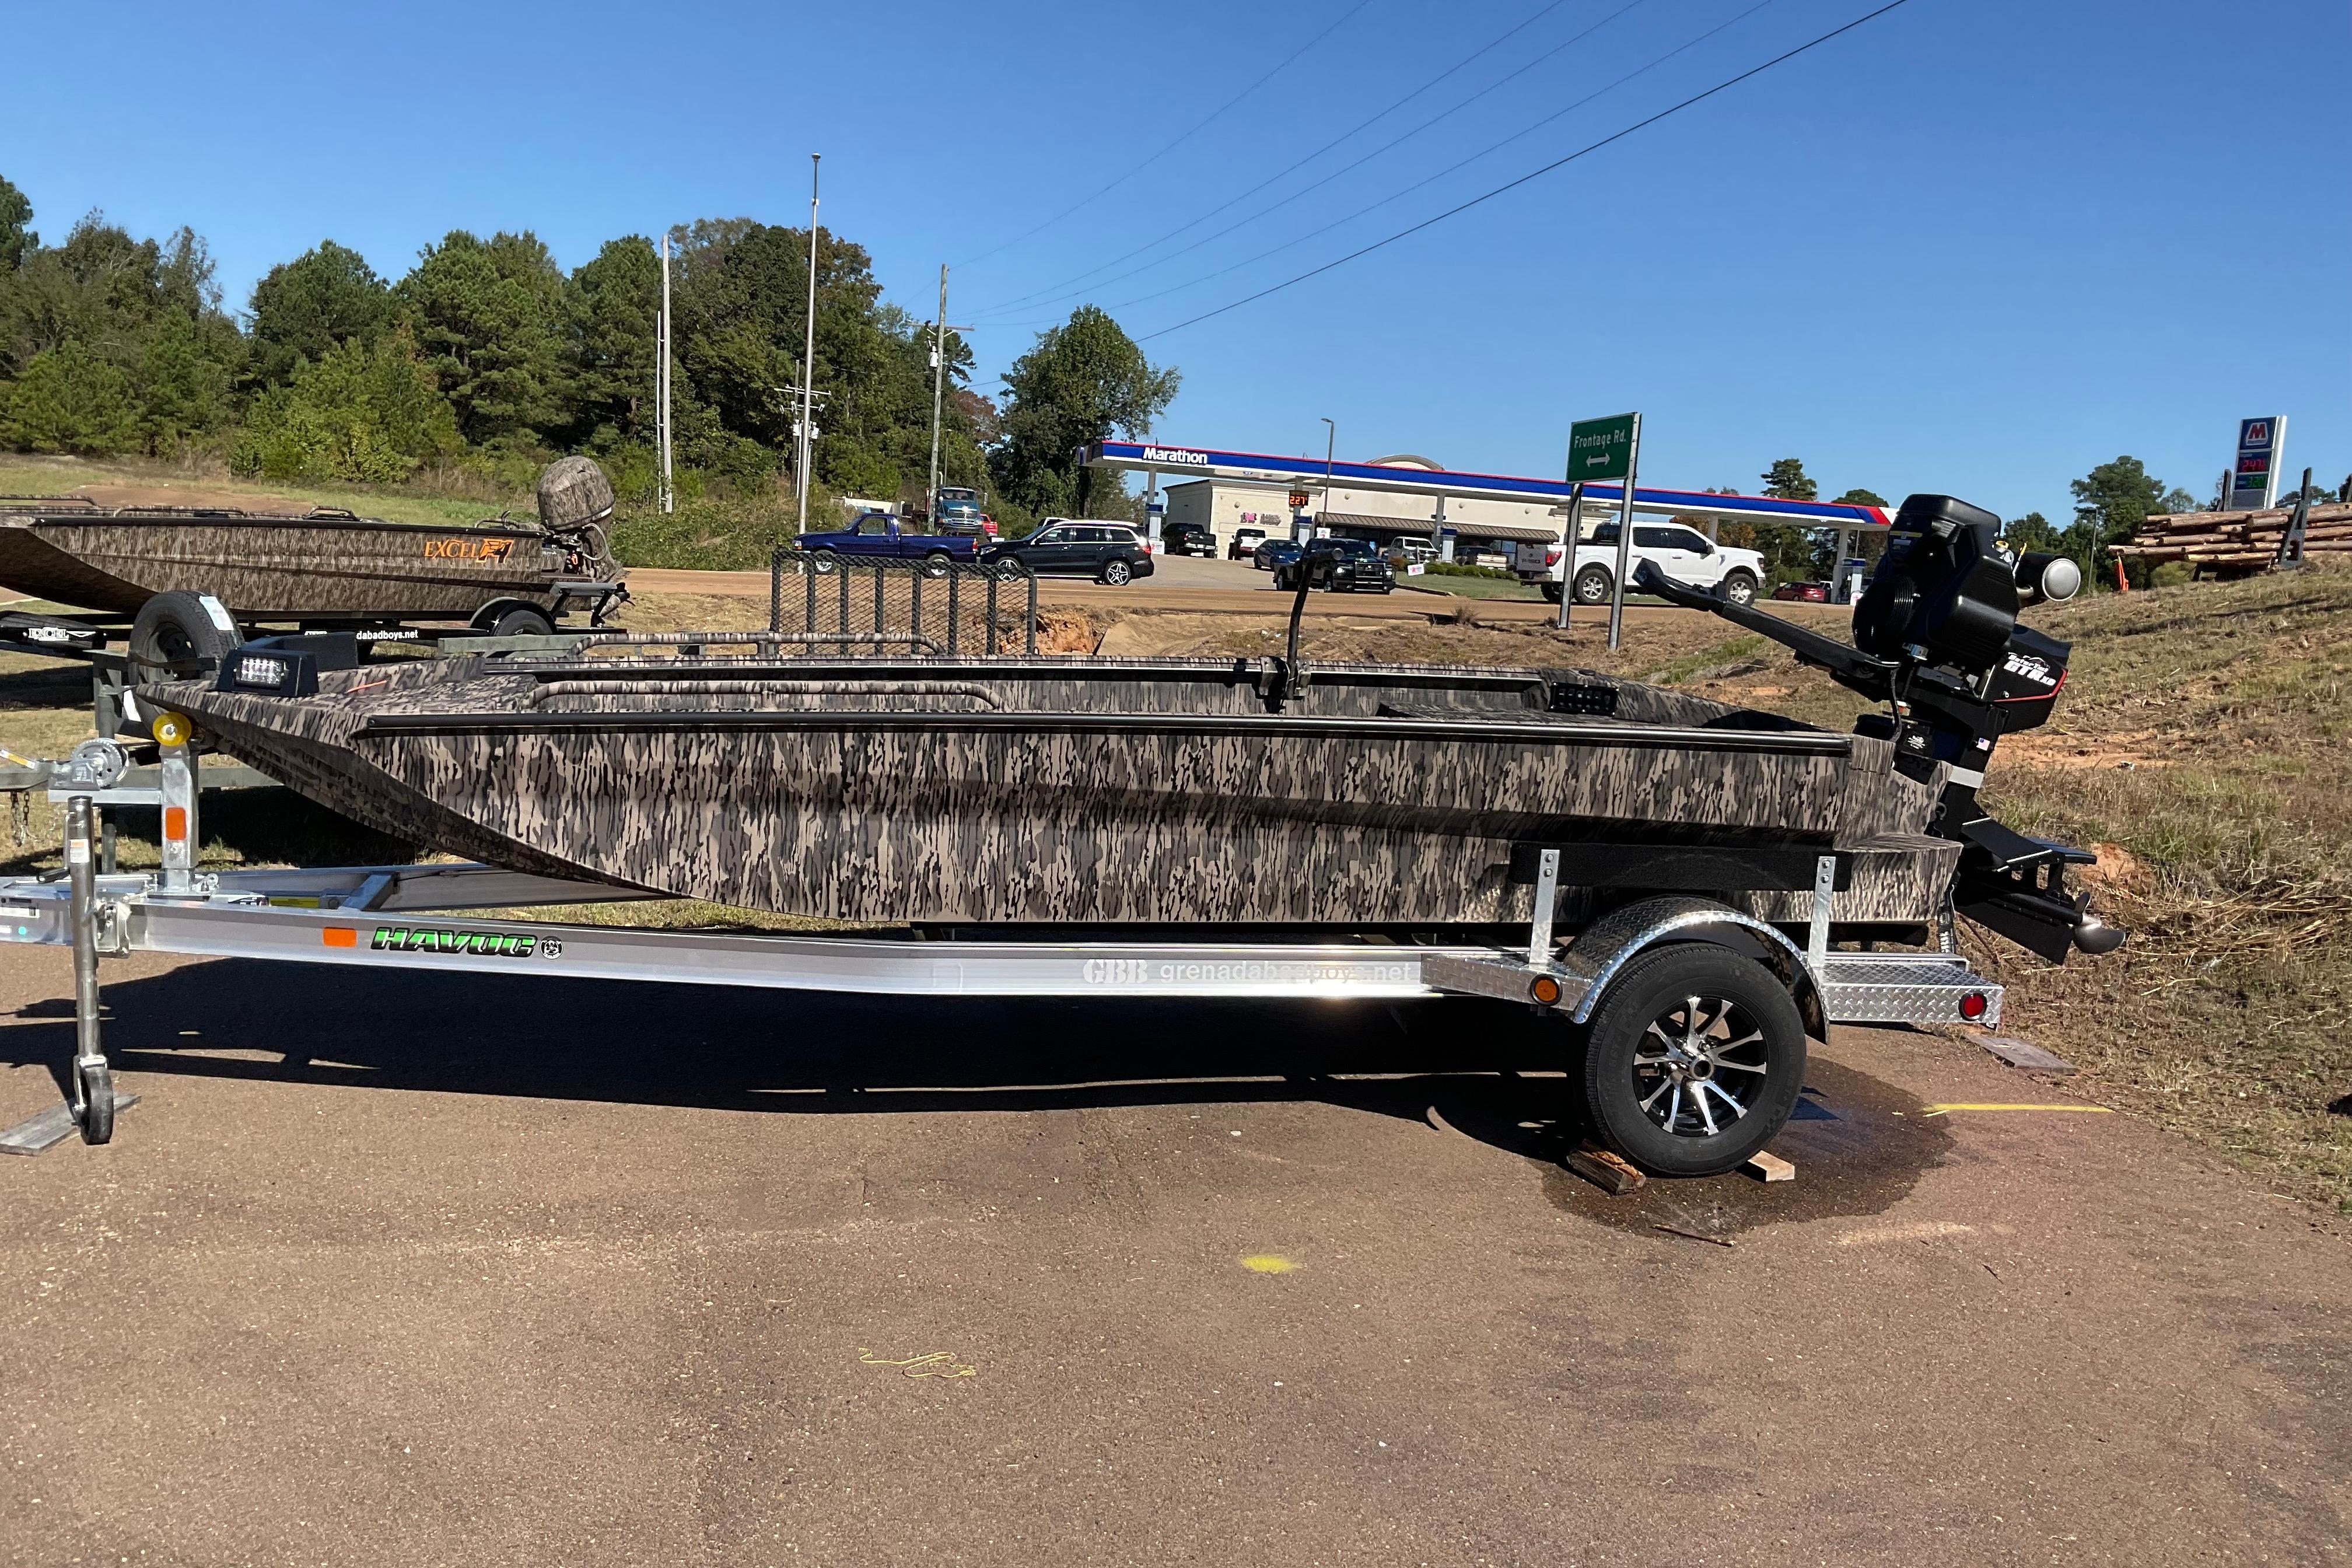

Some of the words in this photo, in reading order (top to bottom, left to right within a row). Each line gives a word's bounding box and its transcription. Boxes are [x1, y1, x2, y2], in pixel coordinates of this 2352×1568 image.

[1574, 433, 1611, 449] Frontage
[1614, 429, 1627, 443] Rd.
[1143, 446, 1208, 464] Marathon
[424, 539, 480, 559] EXCEL
[28, 626, 69, 641] EXCEL
[356, 629, 419, 640] dabadboys.net
[370, 926, 538, 958] HAVOC
[1083, 958, 1148, 984] GBB
